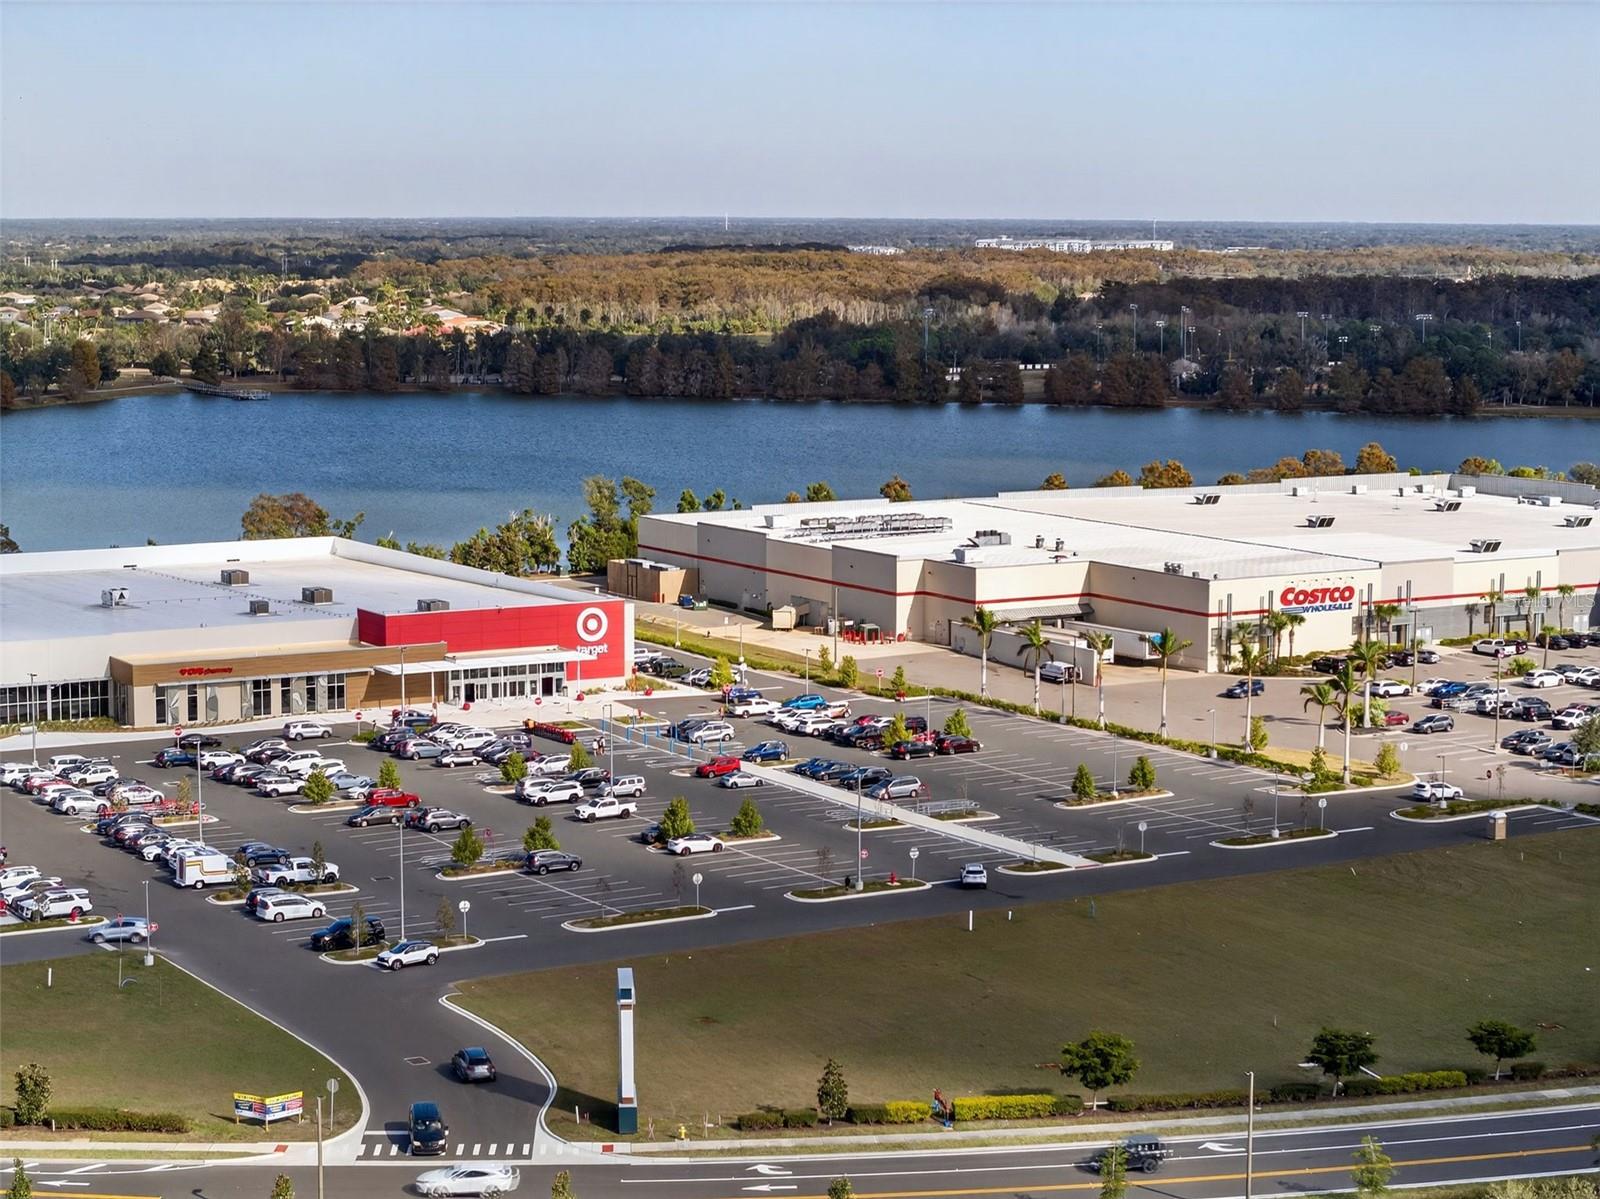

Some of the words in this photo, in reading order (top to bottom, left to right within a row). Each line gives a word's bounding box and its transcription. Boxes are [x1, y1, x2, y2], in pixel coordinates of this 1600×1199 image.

[1280, 586, 1355, 606] COSTCO
[1303, 602, 1352, 613] WHOLESALE
[576, 643, 608, 656] target
